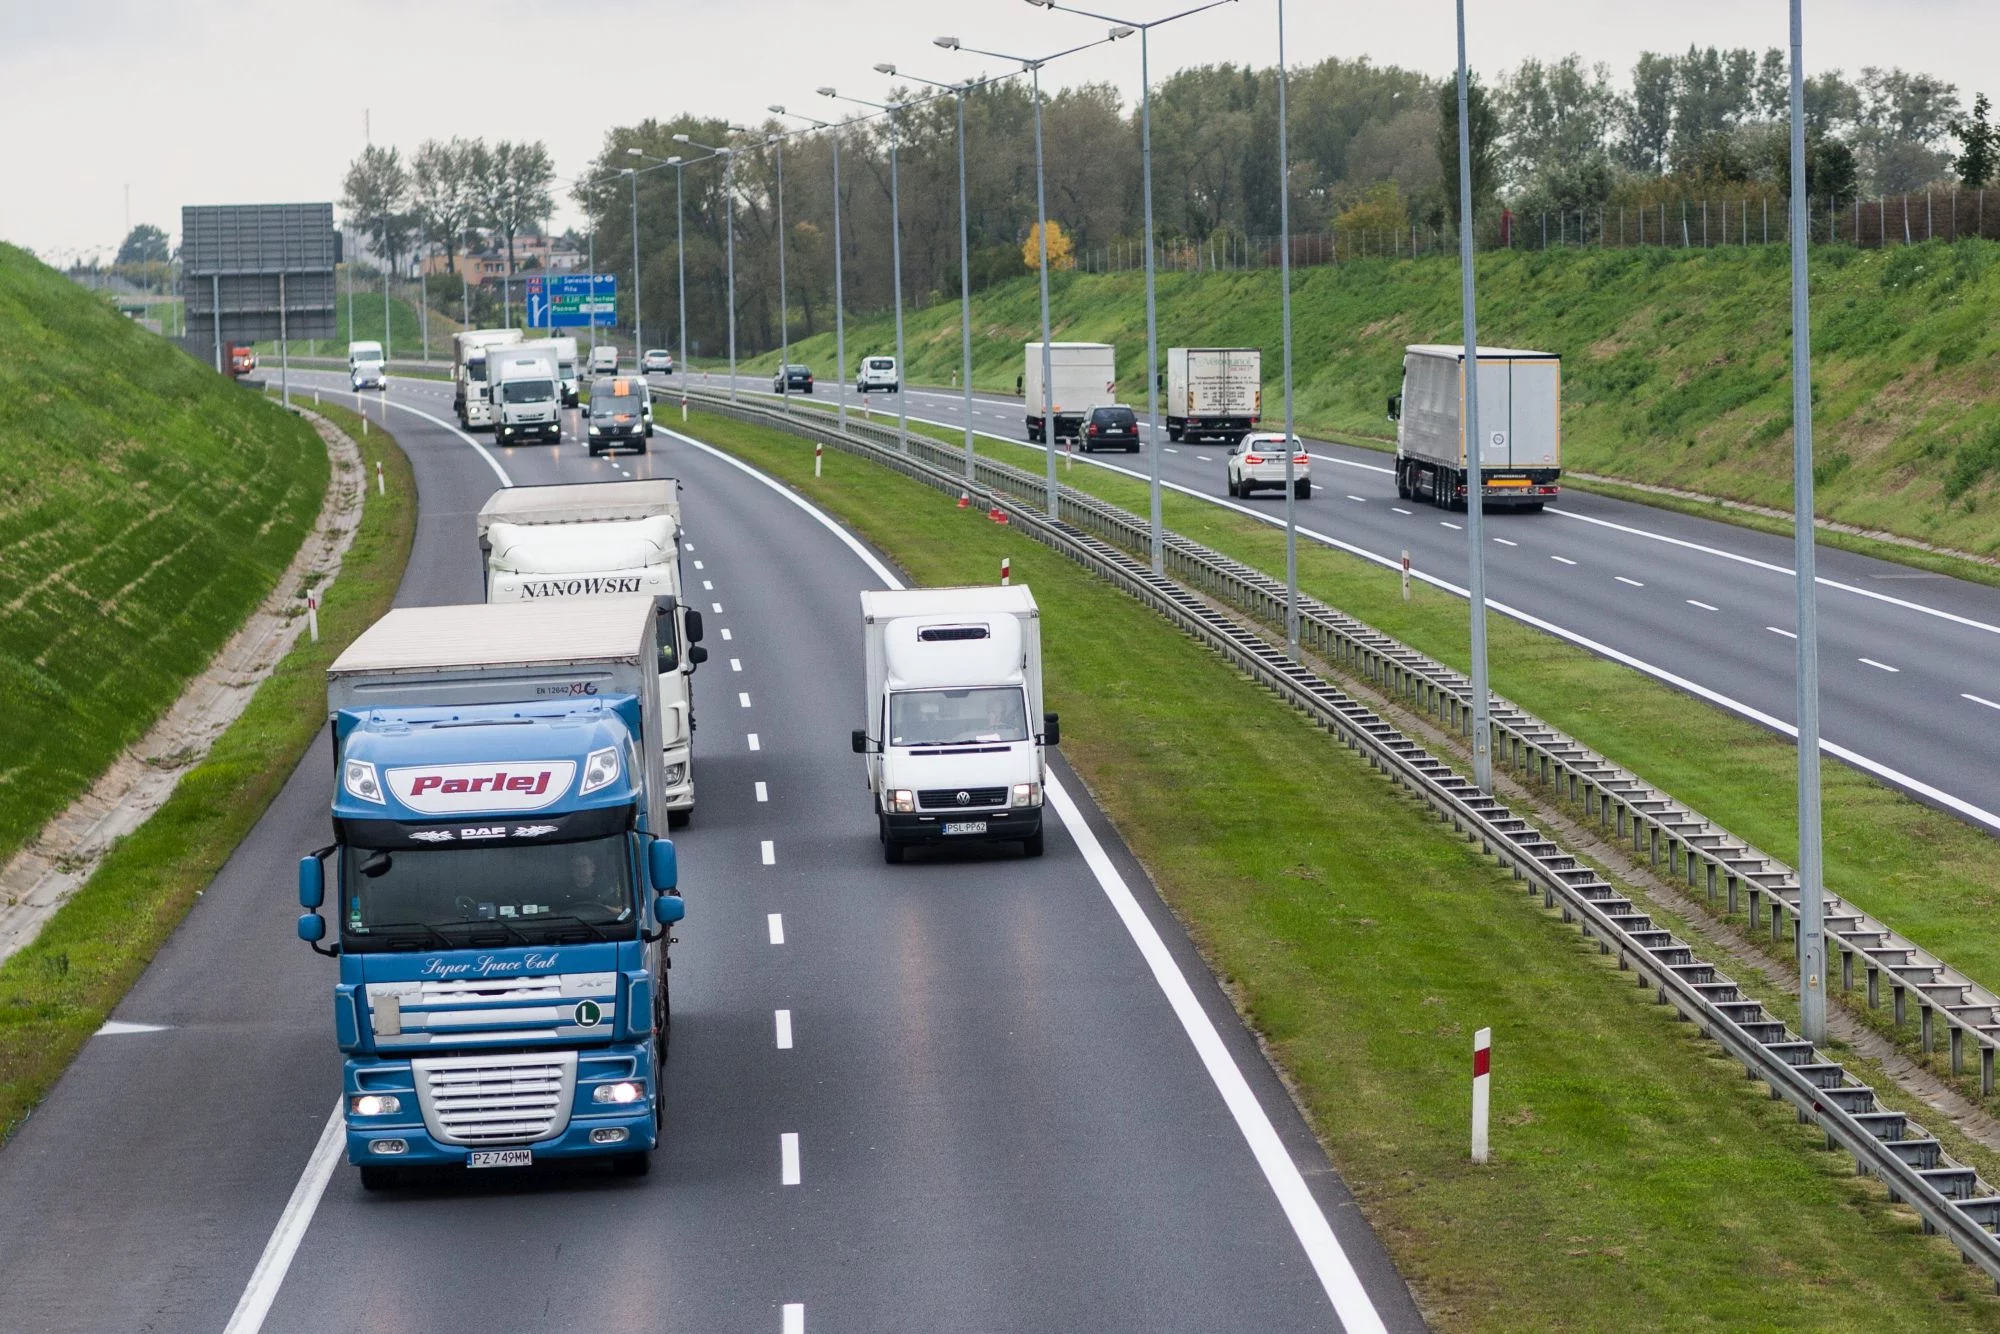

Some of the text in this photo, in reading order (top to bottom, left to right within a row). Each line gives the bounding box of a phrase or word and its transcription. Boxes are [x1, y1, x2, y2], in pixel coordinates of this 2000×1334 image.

[520, 576, 642, 598] NANOWSKI
[536, 687, 546, 695] EN
[410, 771, 552, 796] Parlej
[461, 826, 506, 837] DAF
[947, 824, 964, 833] PSL
[421, 952, 559, 978] Super Space Cab
[473, 1151, 530, 1165] PZ 749MM
